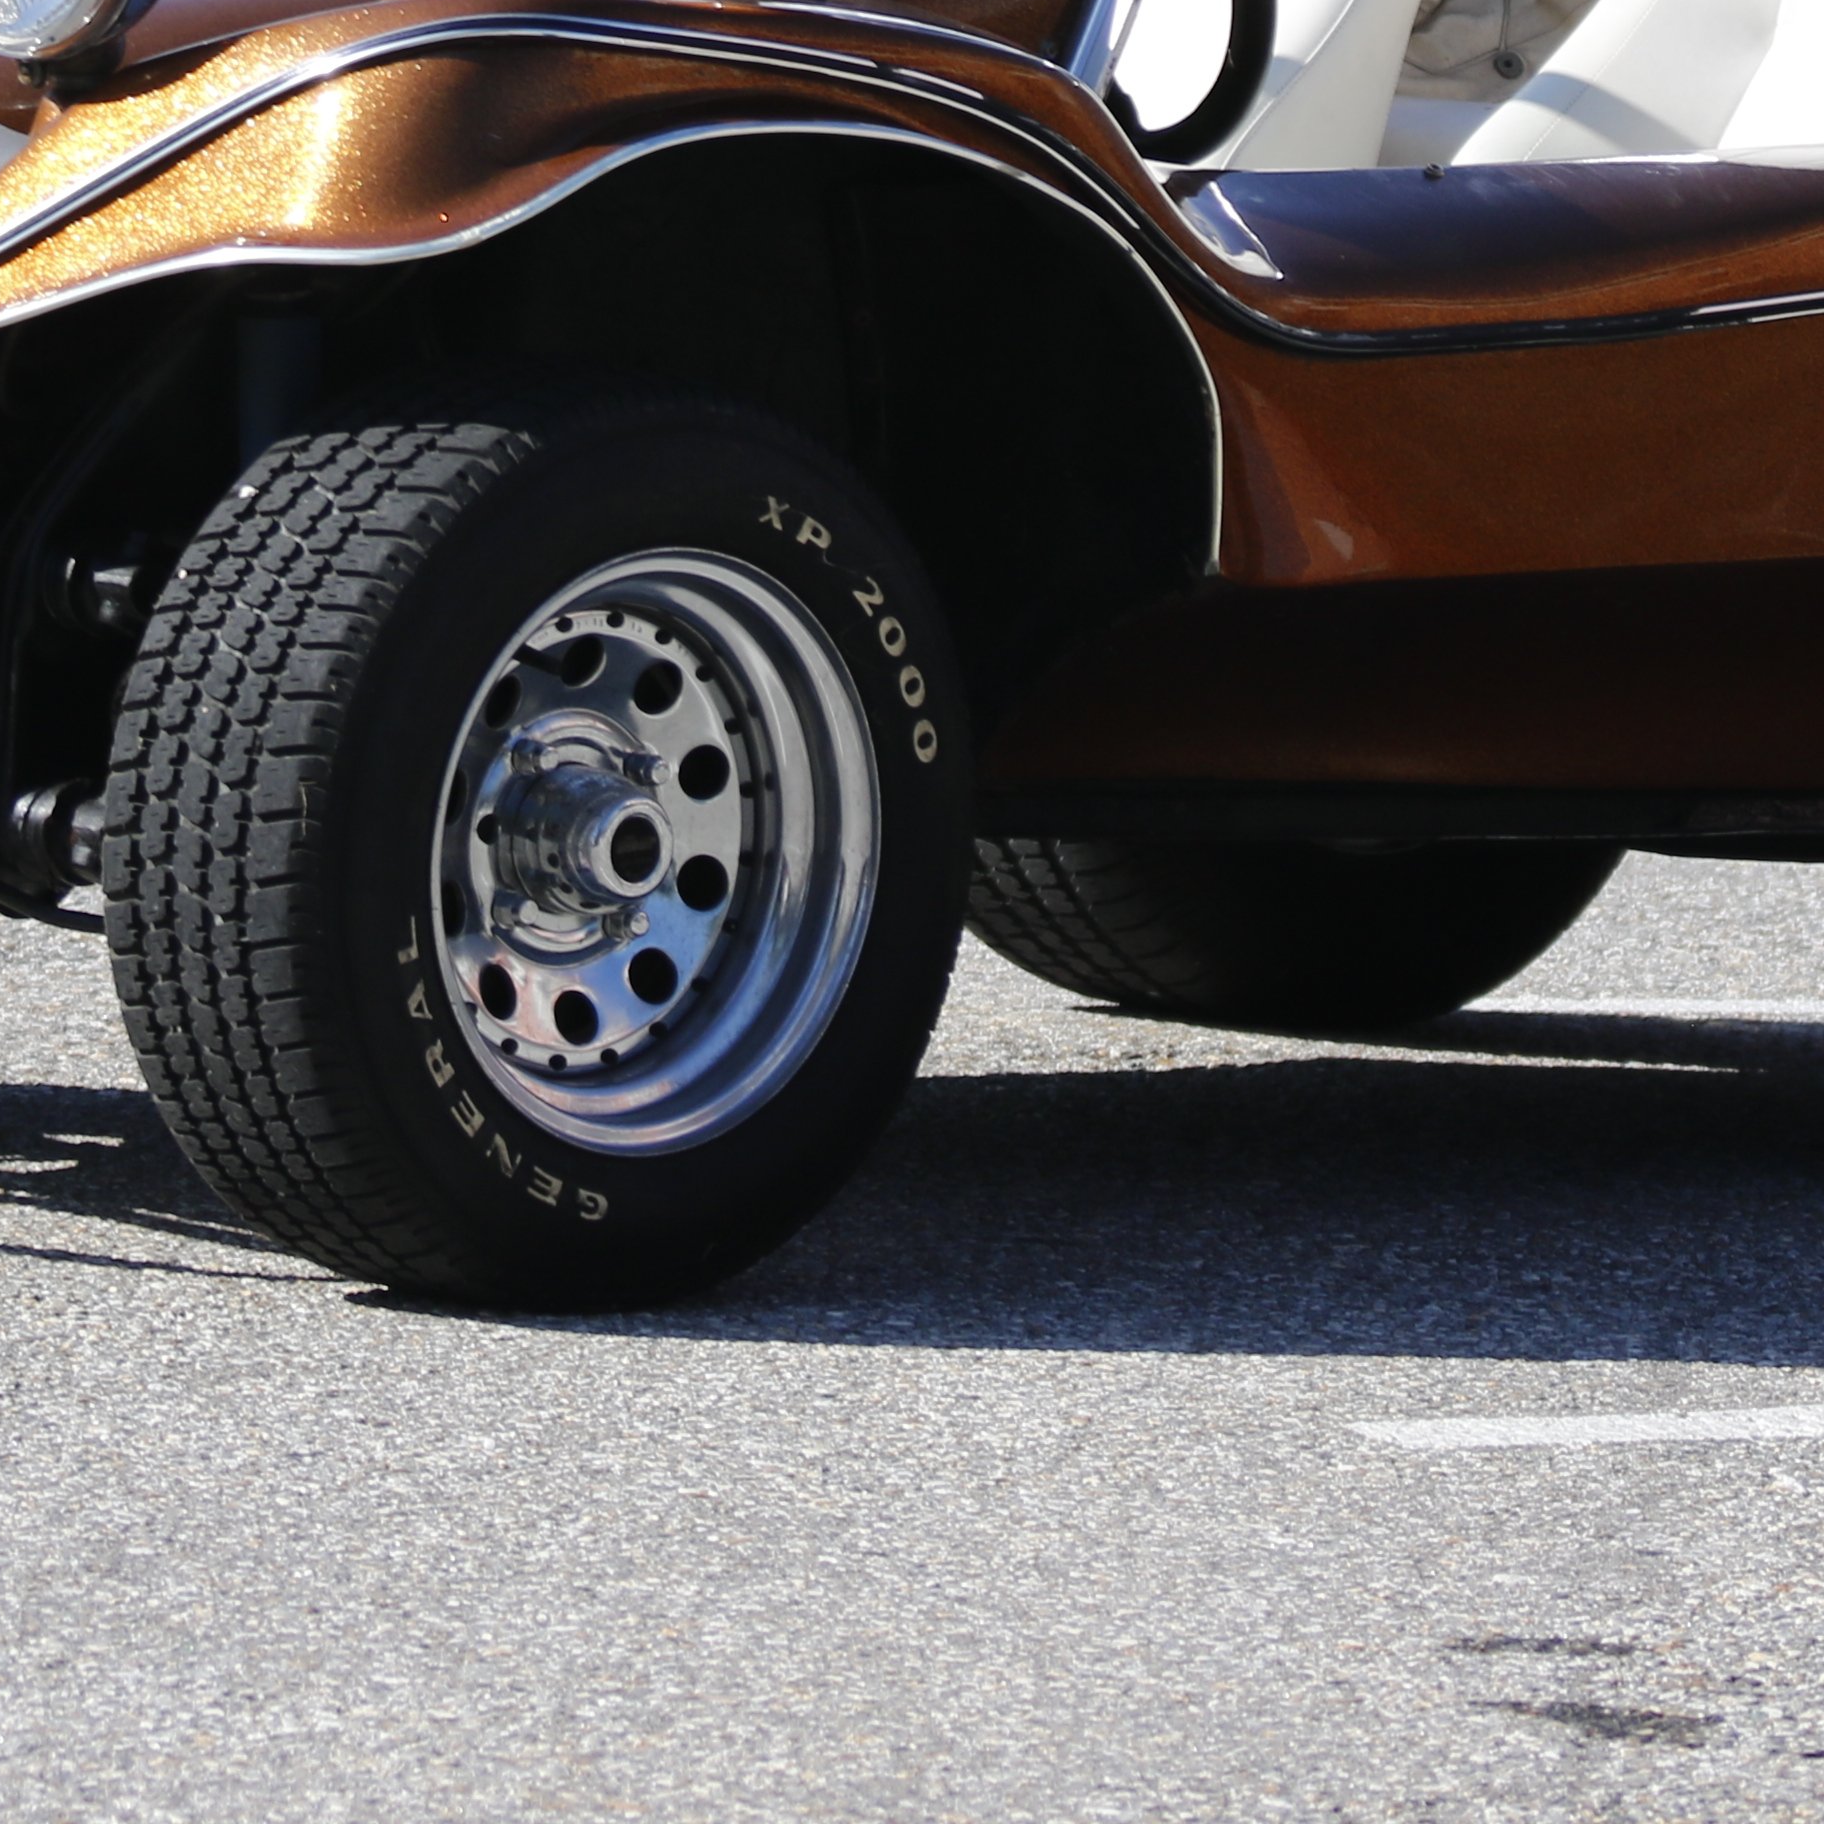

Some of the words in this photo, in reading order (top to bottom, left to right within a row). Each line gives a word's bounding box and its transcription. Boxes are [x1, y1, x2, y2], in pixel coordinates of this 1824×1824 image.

[757, 494, 833, 551] XP
[852, 575, 939, 764] 2000
[397, 915, 609, 1223] GENERAL
